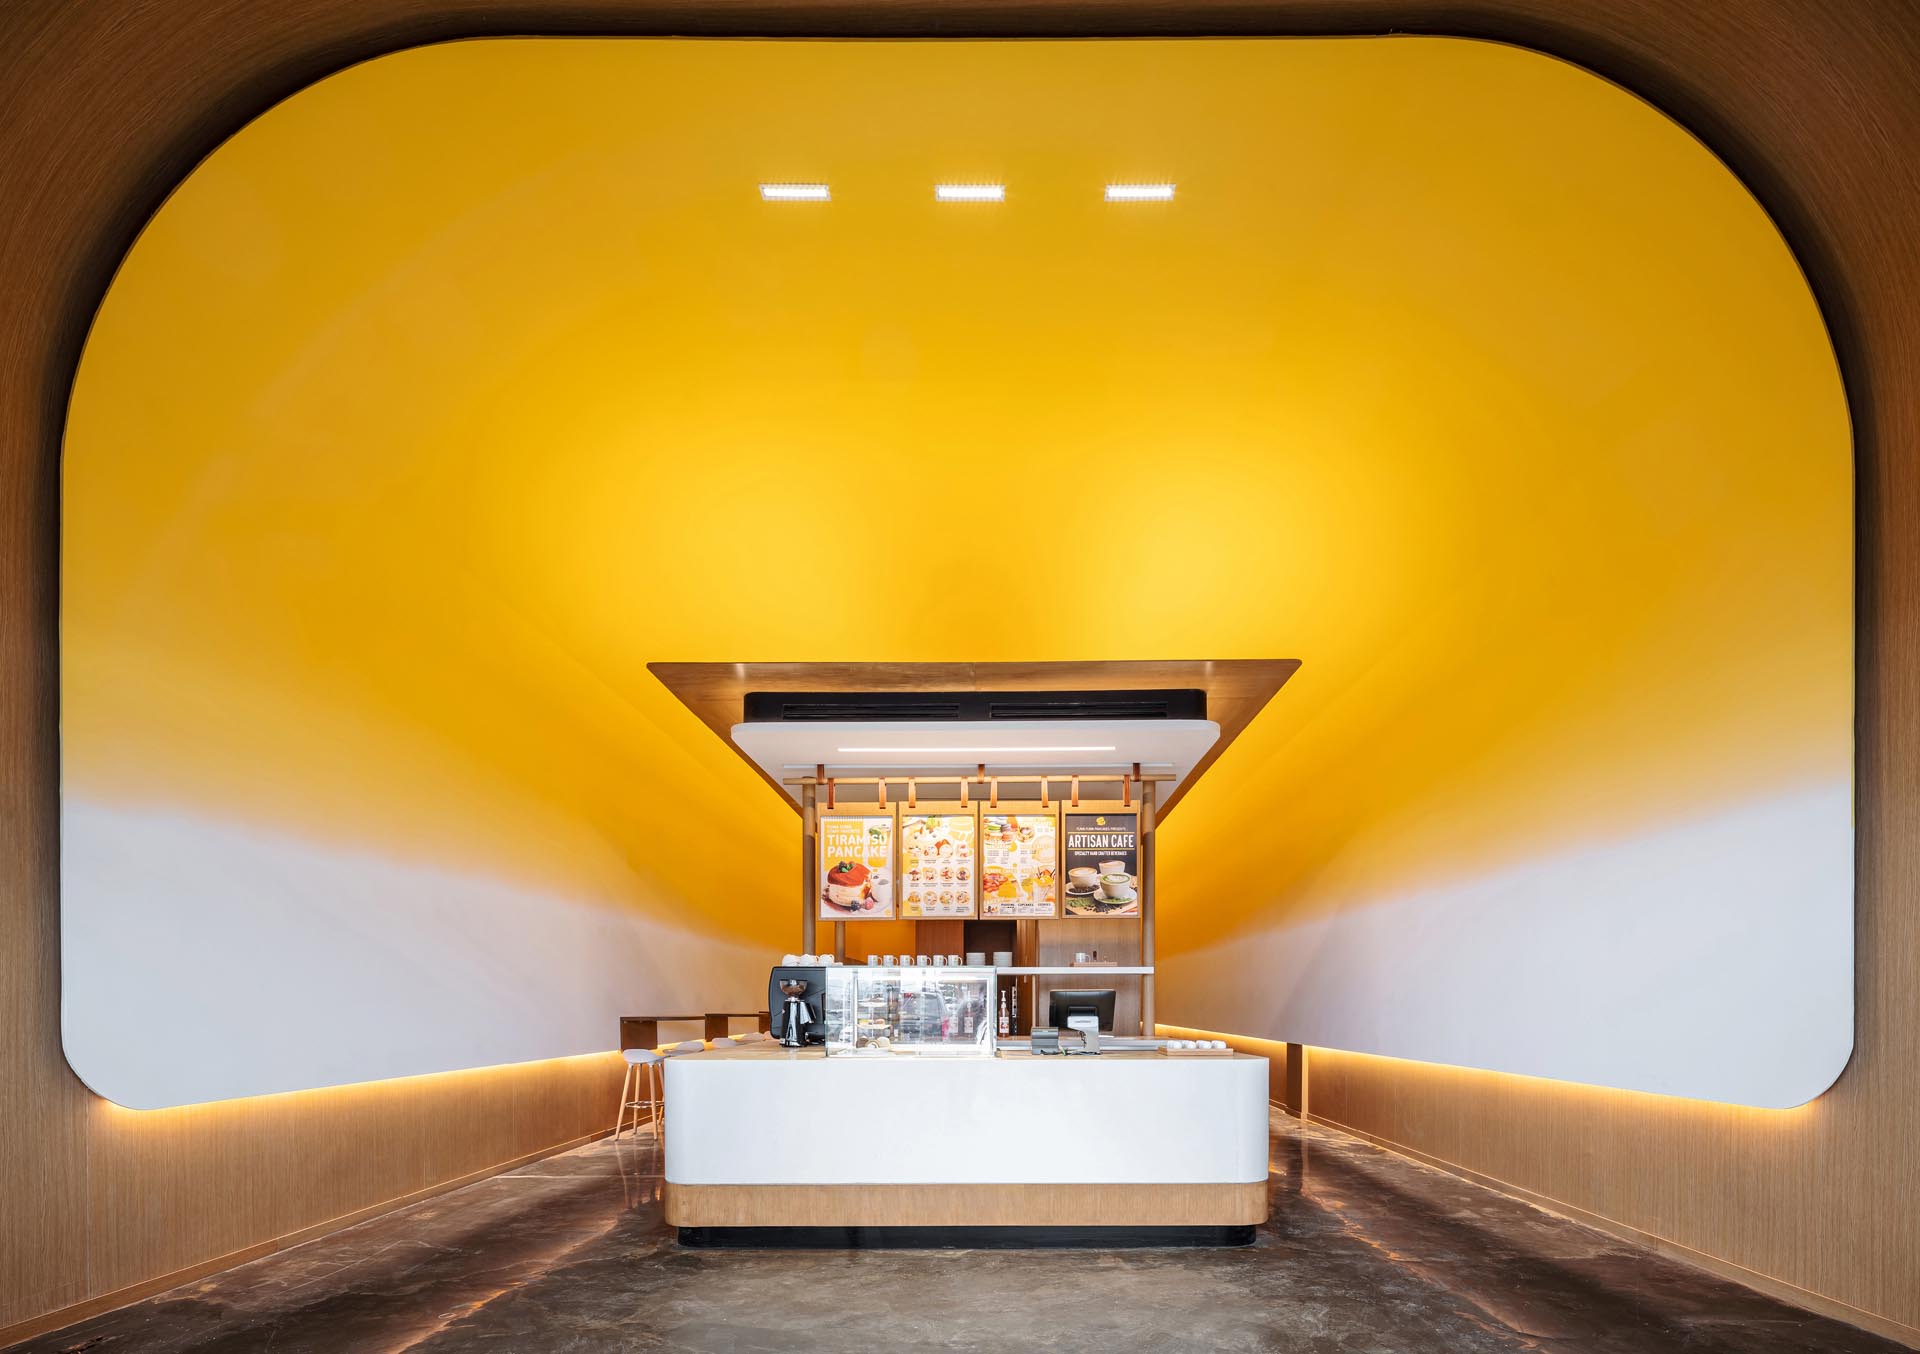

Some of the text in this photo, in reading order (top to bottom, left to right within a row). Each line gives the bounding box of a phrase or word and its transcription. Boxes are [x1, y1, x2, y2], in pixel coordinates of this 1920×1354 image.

[827, 834, 887, 845] TIRAMISU
[1068, 834, 1134, 848] ARTISAN CAFE
[827, 846, 887, 858] PANCAKE
